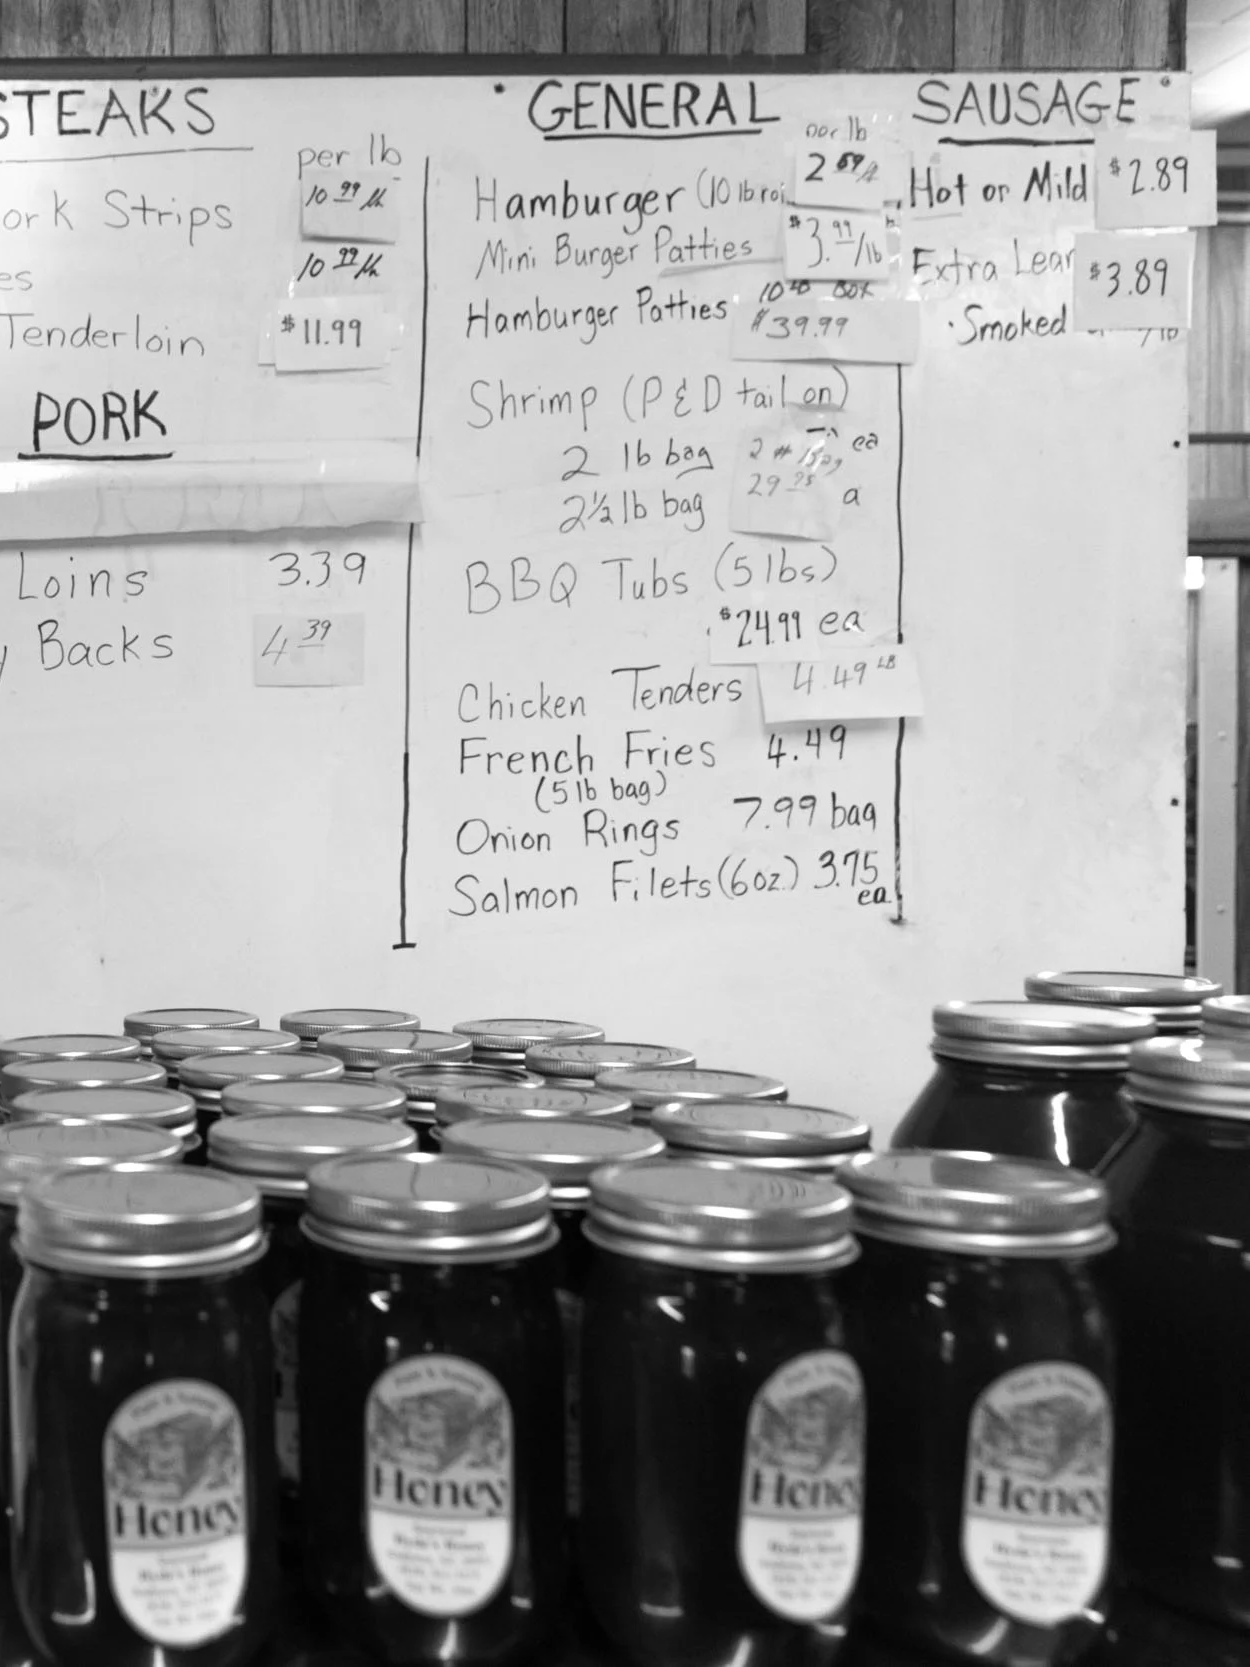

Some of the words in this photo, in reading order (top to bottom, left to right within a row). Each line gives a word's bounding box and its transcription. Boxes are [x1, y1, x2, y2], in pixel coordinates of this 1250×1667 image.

[527, 79, 781, 133] GENERAL
[912, 77, 1141, 126] SAUSAGE
[298, 147, 350, 180] per
[370, 132, 402, 166] lb
[1109, 155, 1190, 196] $2.89
[475, 176, 687, 235] Hamburger
[910, 166, 968, 209] Hot
[982, 182, 1010, 203] or
[1023, 160, 1087, 203] Mild
[104, 188, 234, 246] Strips
[476, 237, 537, 280] Mini
[555, 234, 640, 278] Burger
[654, 226, 754, 264] Patties
[911, 247, 999, 286] Extra
[1089, 257, 1168, 298] $3.89
[281, 314, 363, 348] $11.99
[466, 295, 620, 344] Hamburger
[636, 285, 729, 325] Patties
[750, 308, 850, 339] $39.99
[957, 304, 1067, 346] Smoked
[32, 388, 167, 452] PORK
[467, 378, 598, 431] Shrimp
[623, 374, 662, 422] (P
[703, 374, 721, 413] D
[736, 373, 786, 409] tail
[802, 365, 849, 410] on)
[562, 445, 600, 480] 2
[623, 441, 651, 467] lb
[665, 436, 714, 480] bag
[623, 490, 648, 524] lb
[662, 488, 706, 532] bag
[17, 551, 149, 600] Loins
[268, 550, 367, 588] 3.39
[466, 556, 577, 614] BBQ
[601, 557, 690, 601] Tubs
[37, 617, 175, 672] Backs
[719, 606, 802, 648] $24.99
[818, 610, 866, 637] ea
[457, 681, 587, 724] Chicken
[611, 663, 744, 711] Tenders
[792, 660, 869, 696] 4.49
[460, 733, 595, 776] French
[625, 729, 717, 770] Fries
[767, 723, 848, 769] 4.49
[609, 769, 668, 809] bag)
[456, 818, 551, 856] Onion
[583, 807, 680, 857] Rings
[733, 794, 818, 831] 7.99
[830, 791, 877, 831] bag
[448, 874, 579, 917] Salmon
[611, 859, 712, 902] Filets
[813, 849, 879, 890] 3.75
[373, 1464, 508, 1518] Honey
[113, 1501, 239, 1541] Honey
